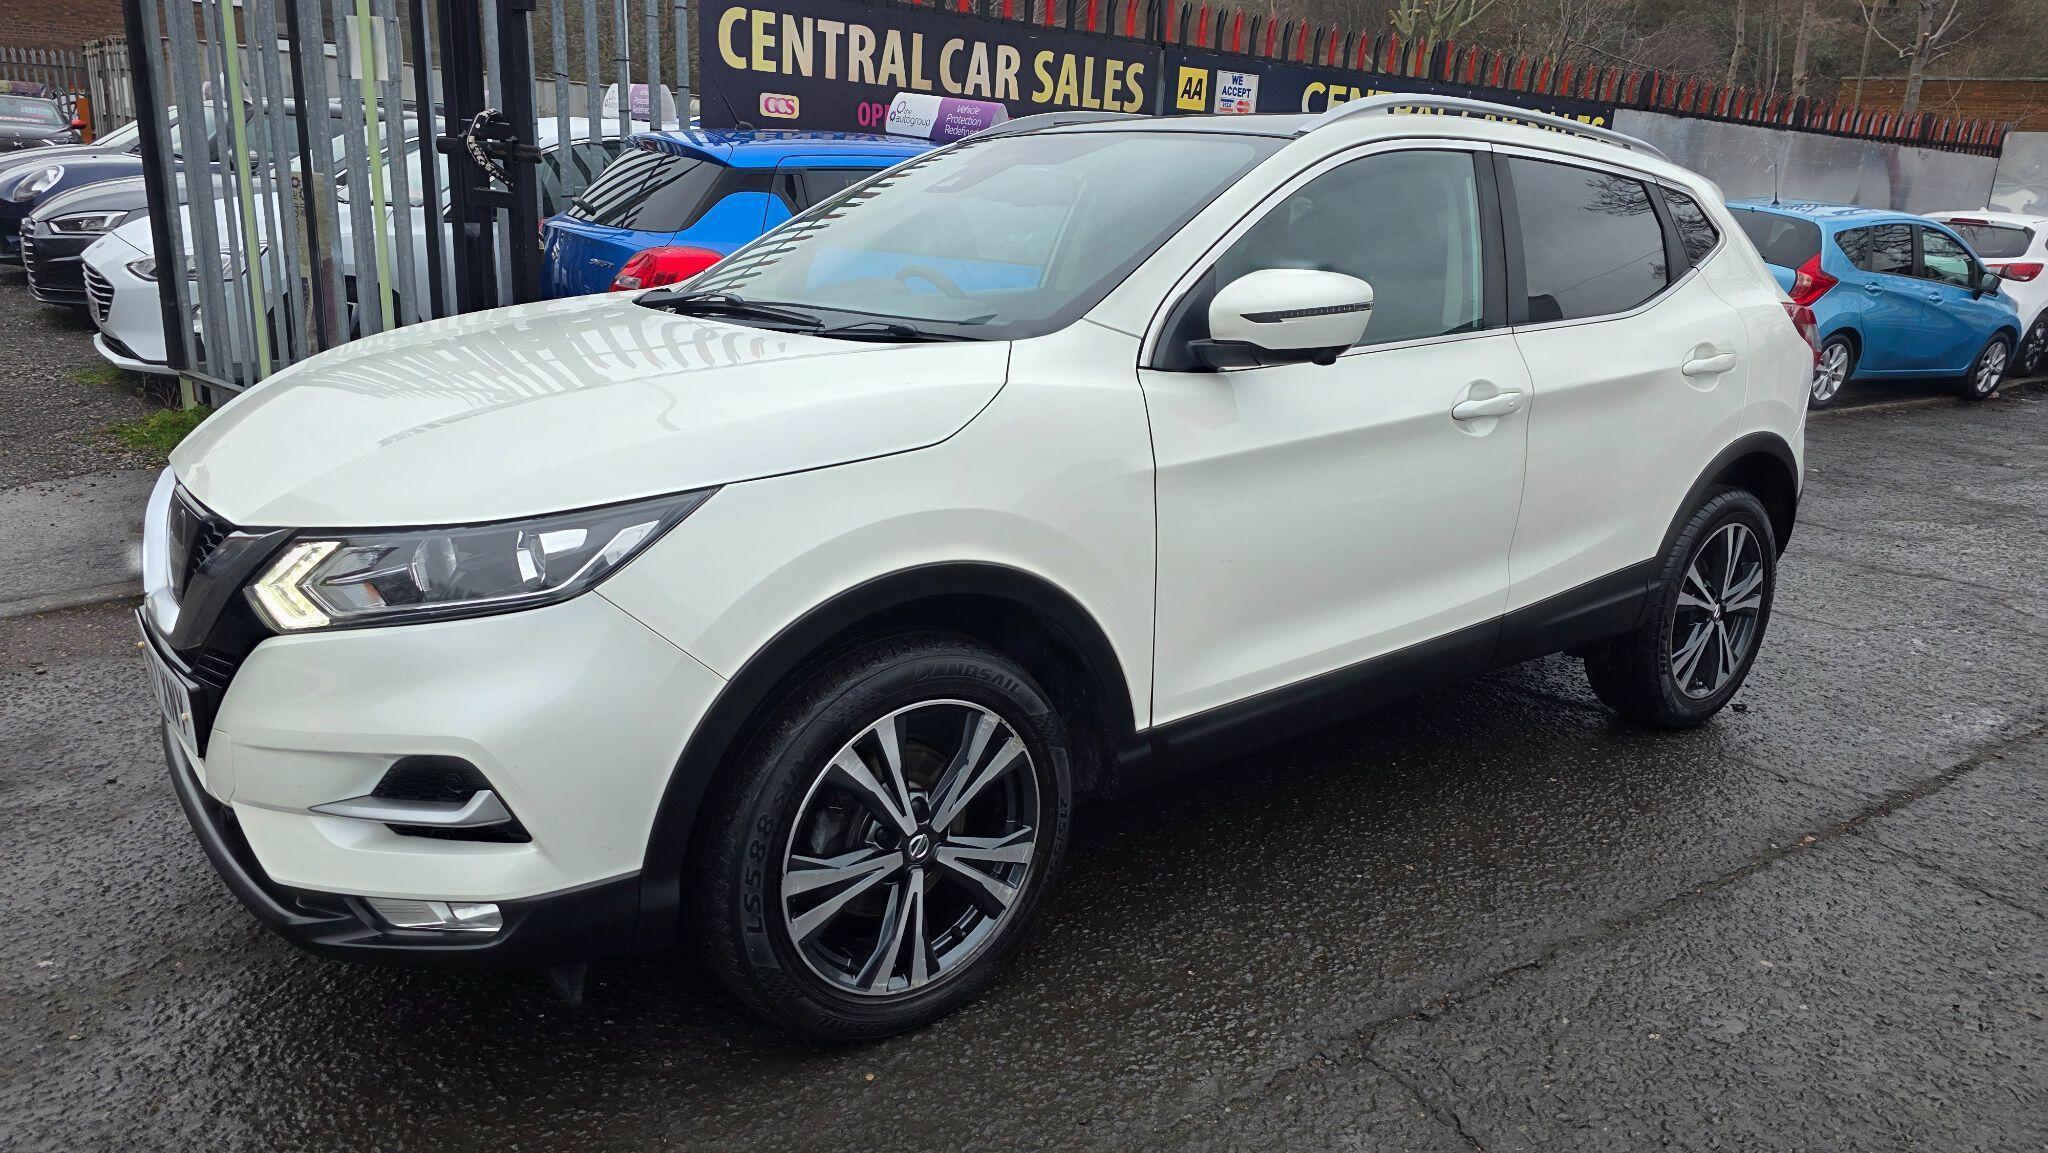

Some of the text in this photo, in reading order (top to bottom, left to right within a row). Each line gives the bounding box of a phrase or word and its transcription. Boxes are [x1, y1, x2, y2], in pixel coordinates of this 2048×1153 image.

[718, 6, 1145, 113] CENTRAL CAR SALES
[1231, 74, 1244, 86] WE
[1180, 76, 1204, 101] AA
[1221, 85, 1252, 99] ACCEPT
[763, 96, 796, 116] CCS
[957, 105, 981, 115] Vehicle
[895, 115, 931, 127] autogroup
[945, 113, 982, 126] Protection
[589, 257, 616, 270] SWIFT
[743, 812, 776, 935] LS588
